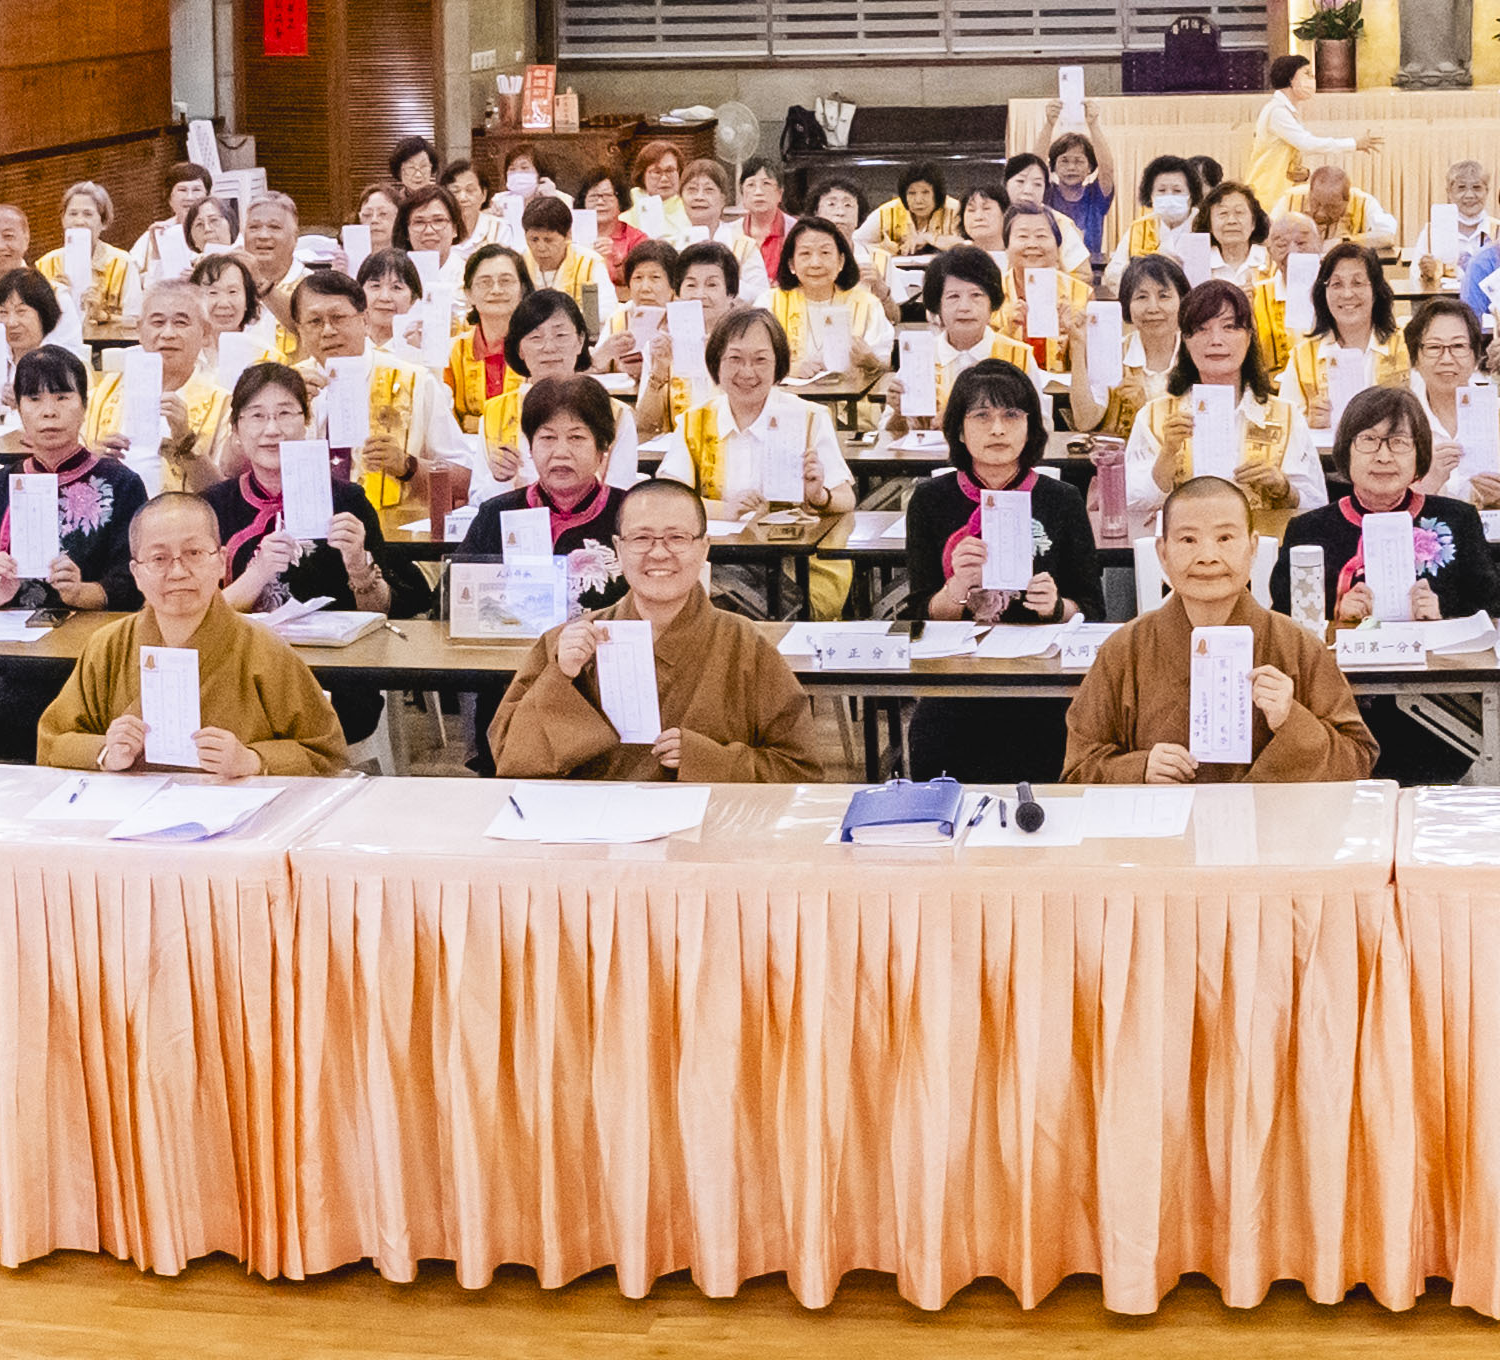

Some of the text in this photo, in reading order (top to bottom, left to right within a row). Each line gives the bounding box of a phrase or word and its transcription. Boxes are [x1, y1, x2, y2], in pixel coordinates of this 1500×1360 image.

[825, 646, 908, 660] 中正分會
[1339, 640, 1423, 654] 大同第一分會
